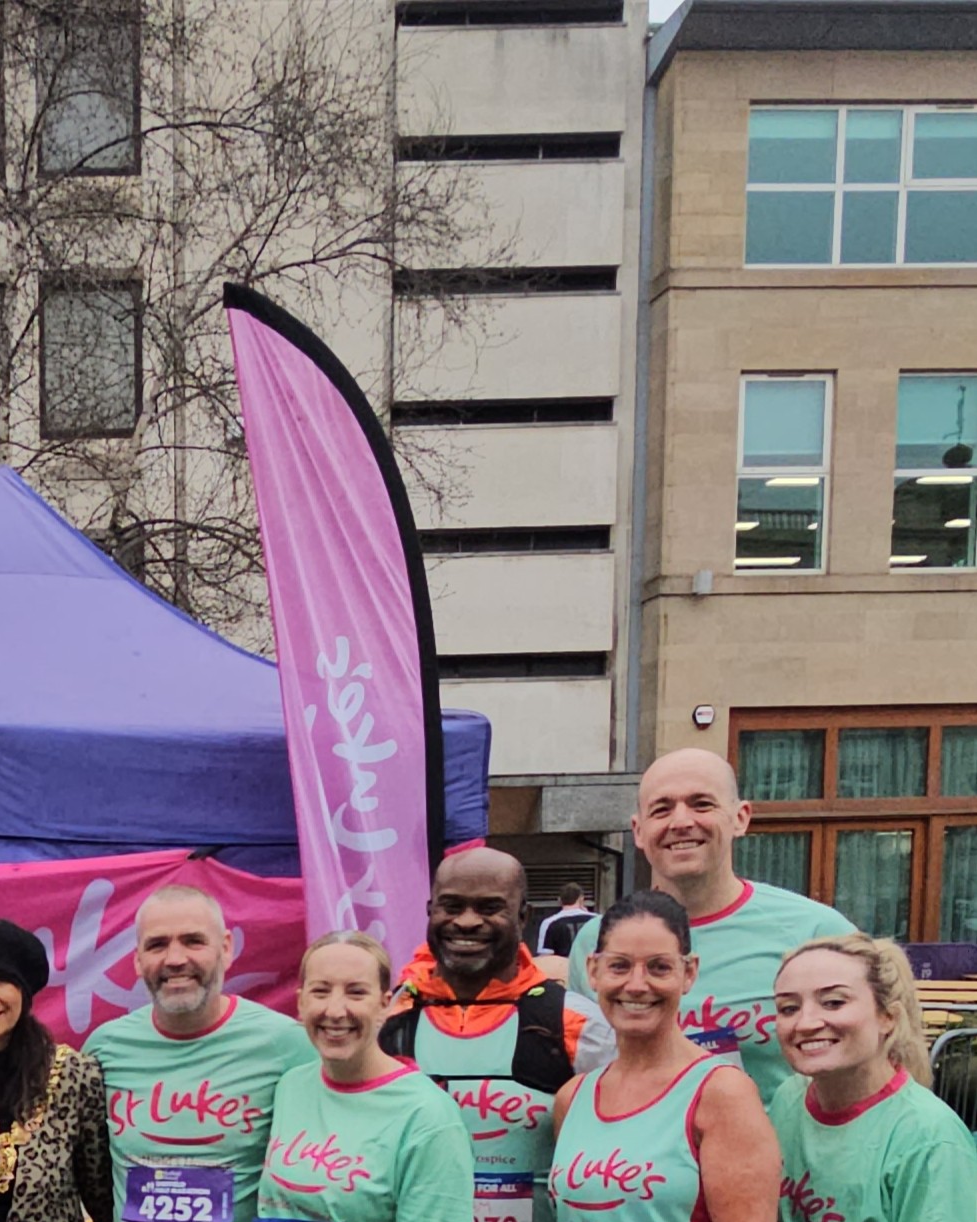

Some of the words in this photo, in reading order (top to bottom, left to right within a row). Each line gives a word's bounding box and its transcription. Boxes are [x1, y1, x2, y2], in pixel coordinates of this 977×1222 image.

[676, 995, 777, 1045] uke's
[108, 1089, 144, 1137] St
[149, 1080, 263, 1135] Luke's
[452, 1078, 548, 1131] uke's
[282, 1129, 371, 1193] Luke's
[476, 1155, 517, 1165] ospice
[549, 1164, 564, 1198] t
[566, 1147, 667, 1201] Luke's
[138, 1194, 214, 1222] 4252
